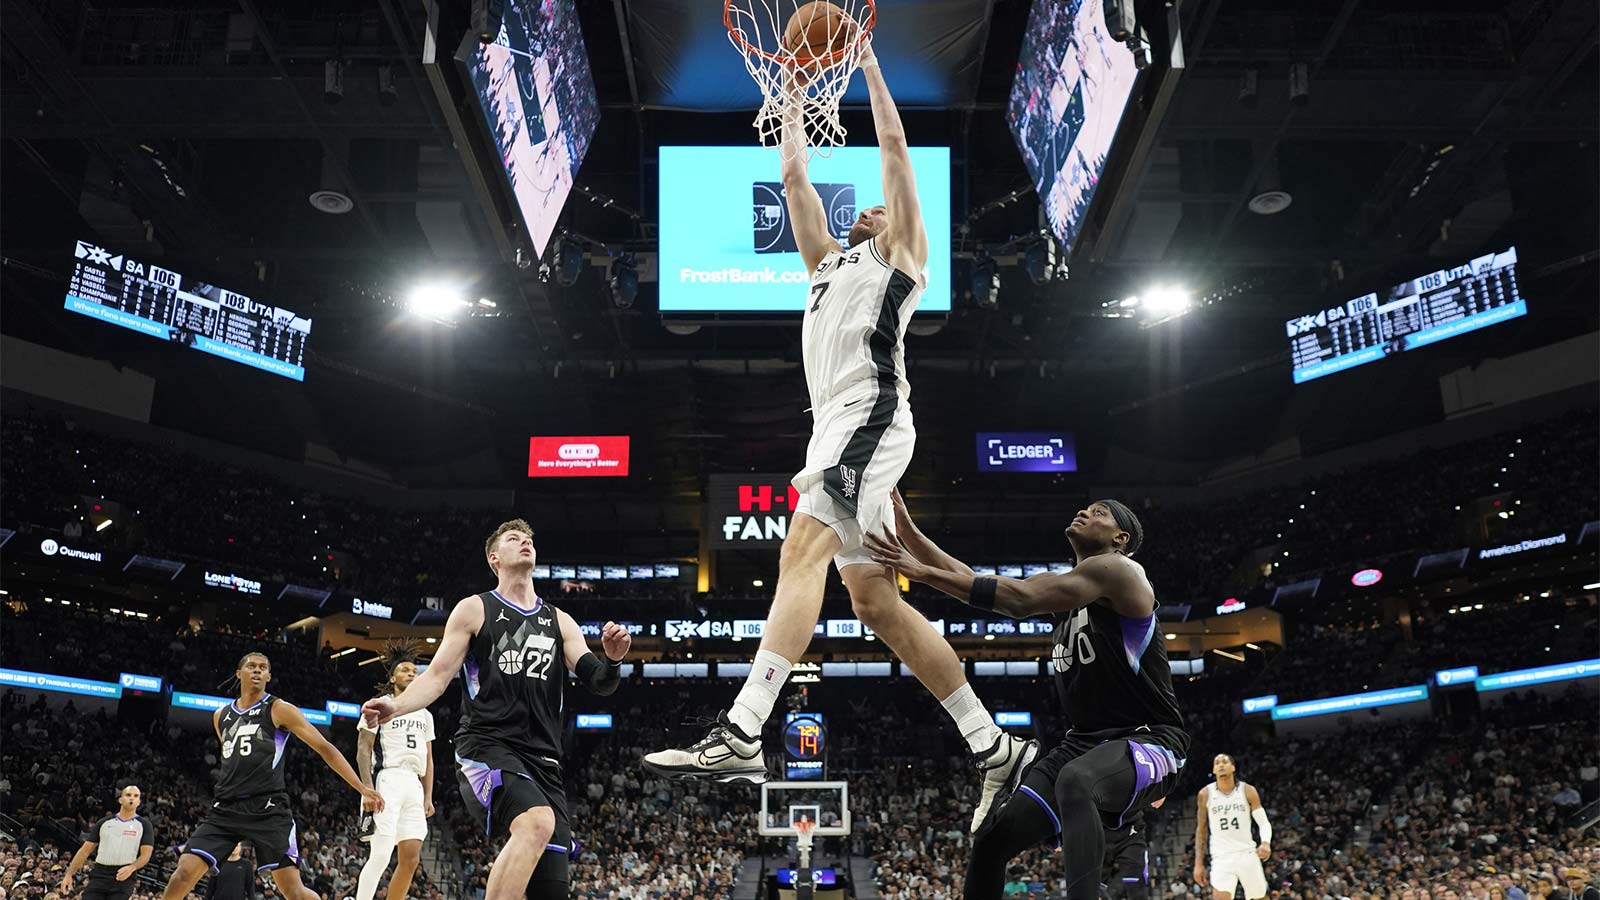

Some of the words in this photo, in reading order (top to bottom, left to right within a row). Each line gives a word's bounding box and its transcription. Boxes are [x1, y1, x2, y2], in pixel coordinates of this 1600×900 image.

[126, 260, 144, 276] SA
[1446, 264, 1472, 282] UTA
[154, 268, 176, 287] 106
[1420, 274, 1441, 290] 108
[225, 293, 245, 310] 108
[811, 282, 829, 313] 7
[1352, 296, 1372, 313] 106
[73, 301, 100, 315] Where
[249, 301, 273, 319] UTA
[1327, 306, 1346, 321] SA
[999, 445, 1053, 458] LEDGER
[556, 460, 596, 469] Everything's
[723, 516, 786, 540] FAN
[60, 546, 101, 562] Ownwell
[1479, 545, 1522, 559] Americus
[1522, 533, 1566, 550] Diamond
[205, 571, 231, 585] LONE
[711, 622, 732, 636] SA
[743, 624, 761, 634] 106
[836, 623, 854, 634] 108
[950, 623, 966, 633] PF
[987, 623, 1015, 633] FG%
[1037, 623, 1053, 633] TO
[526, 651, 552, 680] 22
[797, 726, 819, 737] 7:24
[240, 735, 252, 756] 5
[406, 734, 417, 749] 5
[801, 736, 817, 755] 14
[1211, 803, 1246, 815] SPURS
[1220, 818, 1239, 830] 24
